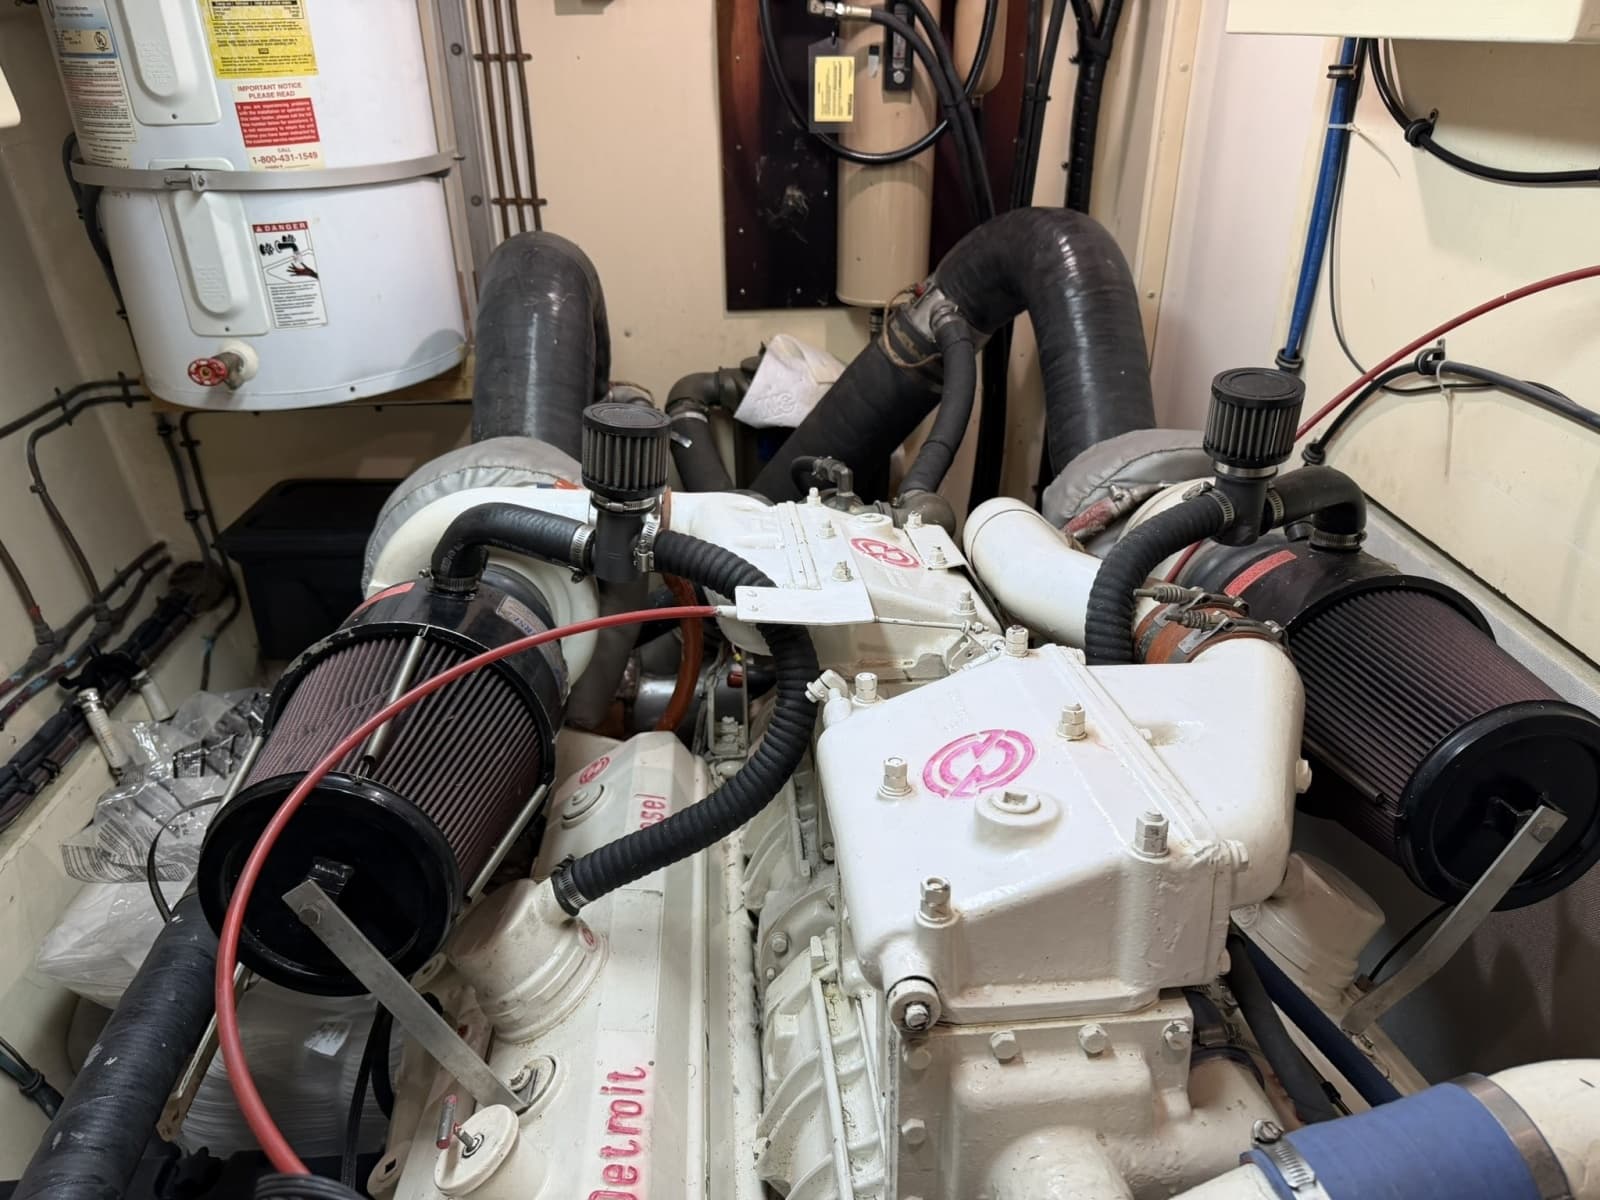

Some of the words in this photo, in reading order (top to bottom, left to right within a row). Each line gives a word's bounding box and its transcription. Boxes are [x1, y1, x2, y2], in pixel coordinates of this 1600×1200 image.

[237, 84, 276, 92] IMPORTANT
[278, 82, 302, 90] NOTICE
[276, 90, 296, 98] READ
[252, 152, 318, 164] 1-800-431-1549
[264, 222, 306, 232] DANGER
